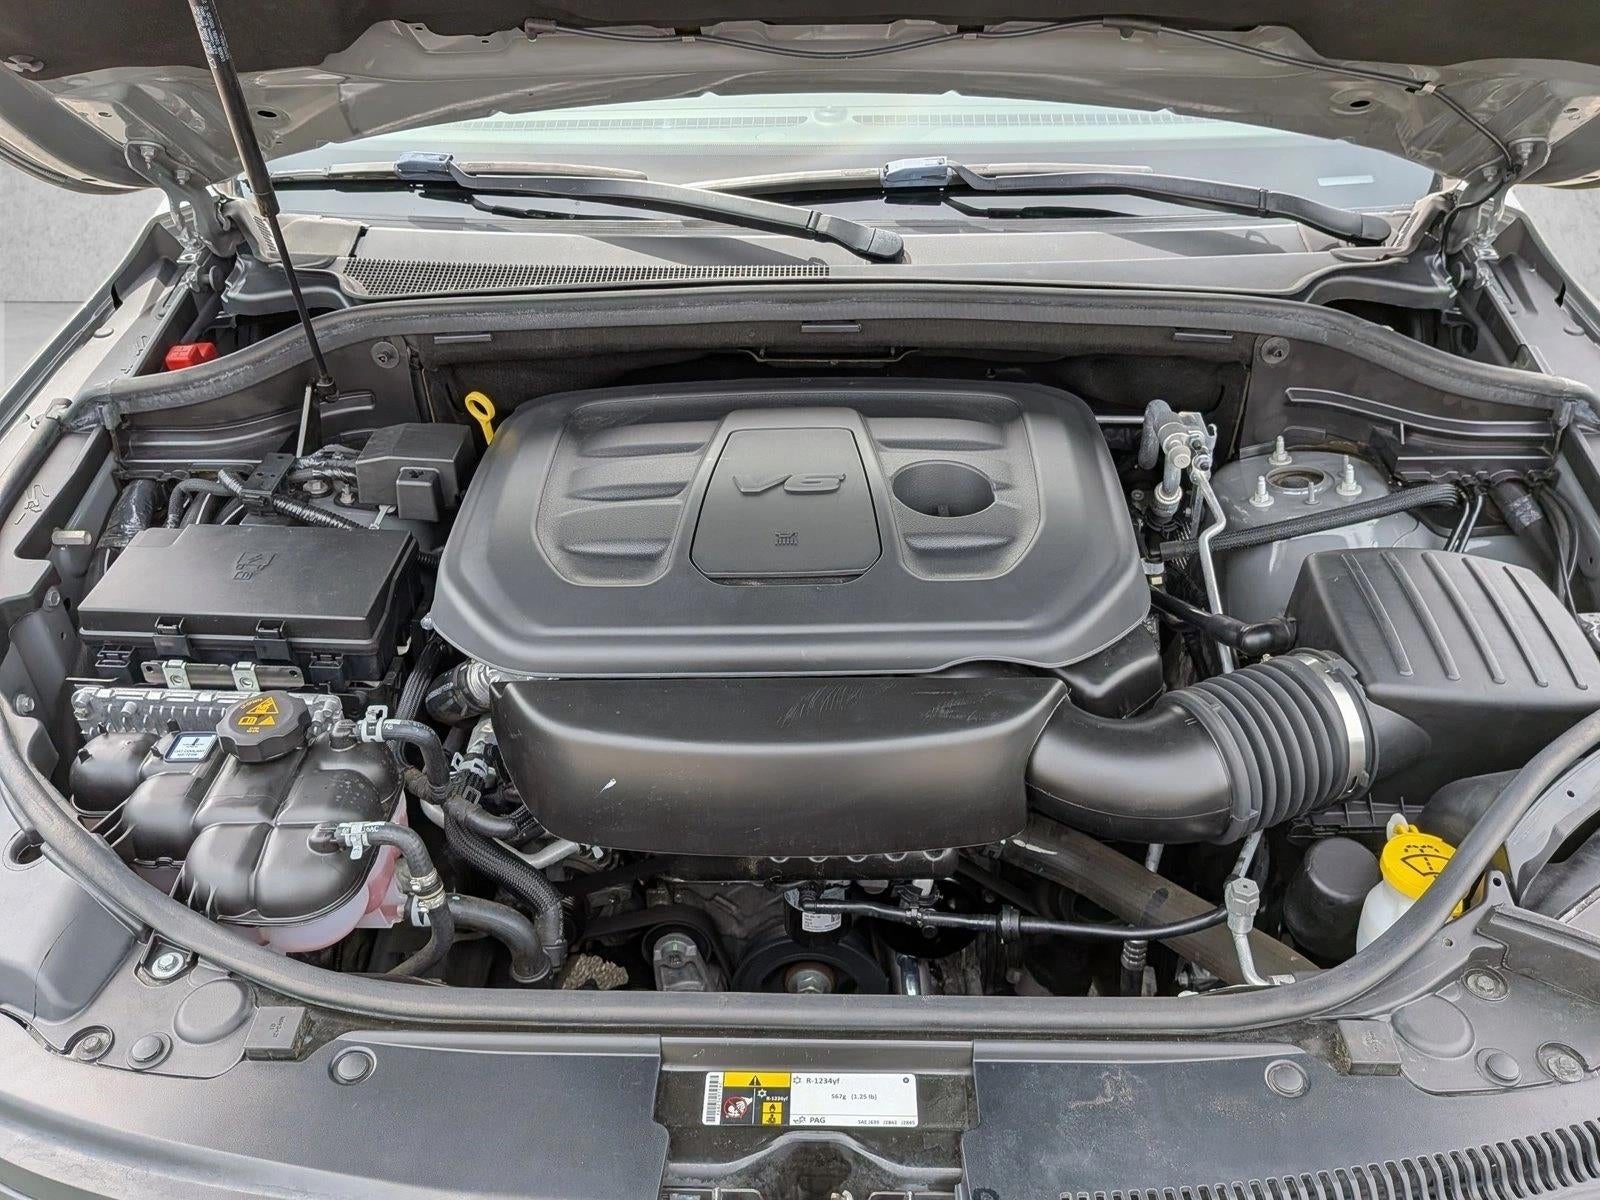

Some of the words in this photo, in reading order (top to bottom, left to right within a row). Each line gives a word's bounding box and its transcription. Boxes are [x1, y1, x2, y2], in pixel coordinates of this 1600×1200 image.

[731, 472, 848, 496] V6
[806, 1077, 840, 1086] R-1234yf
[850, 1093, 867, 1101] (1.25
[868, 1093, 878, 1101] lb)
